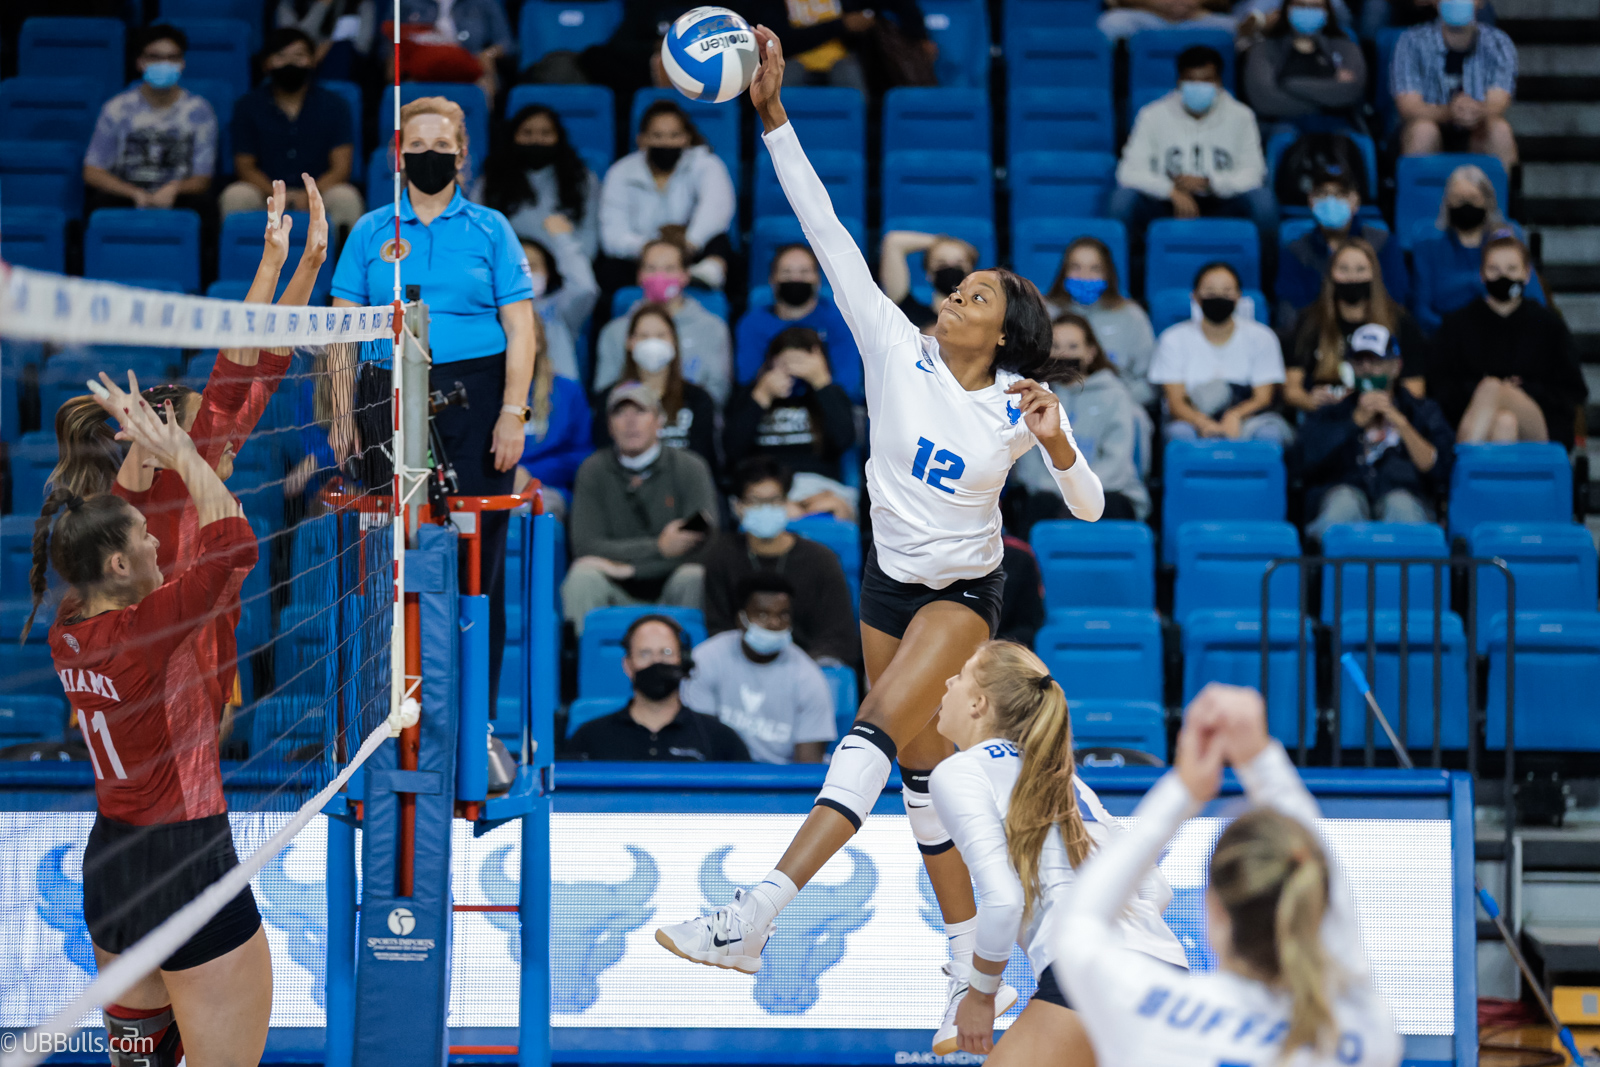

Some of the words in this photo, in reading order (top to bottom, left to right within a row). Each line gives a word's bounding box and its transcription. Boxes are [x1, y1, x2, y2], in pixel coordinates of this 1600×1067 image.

[700, 33, 749, 52] molten
[912, 436, 966, 495] 12
[57, 668, 121, 702] MIAMI
[77, 708, 128, 780] 11
[1137, 988, 1364, 1065] BUFFAO
